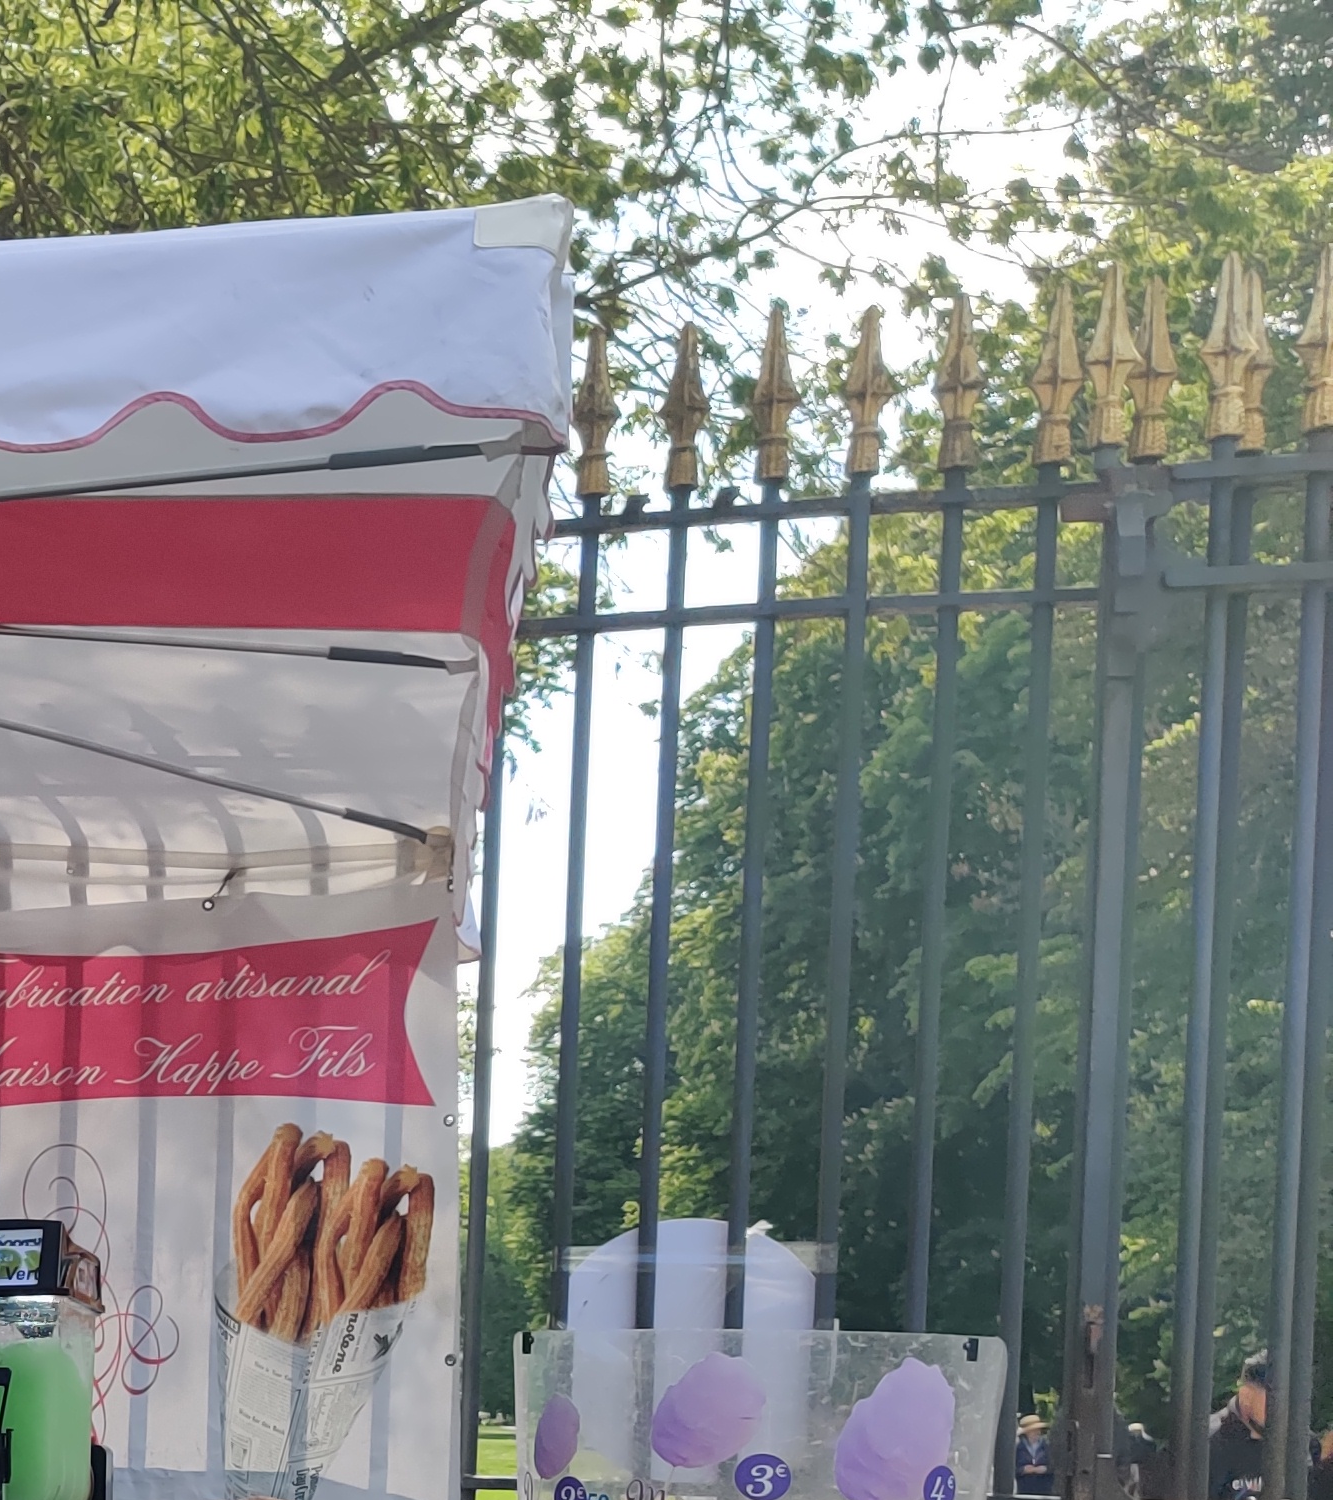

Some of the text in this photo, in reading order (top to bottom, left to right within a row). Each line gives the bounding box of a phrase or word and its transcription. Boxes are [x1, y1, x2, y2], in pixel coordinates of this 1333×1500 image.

[184, 948, 392, 1005] artisanal
[113, 1032, 262, 1095] Happe
[270, 1025, 375, 1080] Fils
